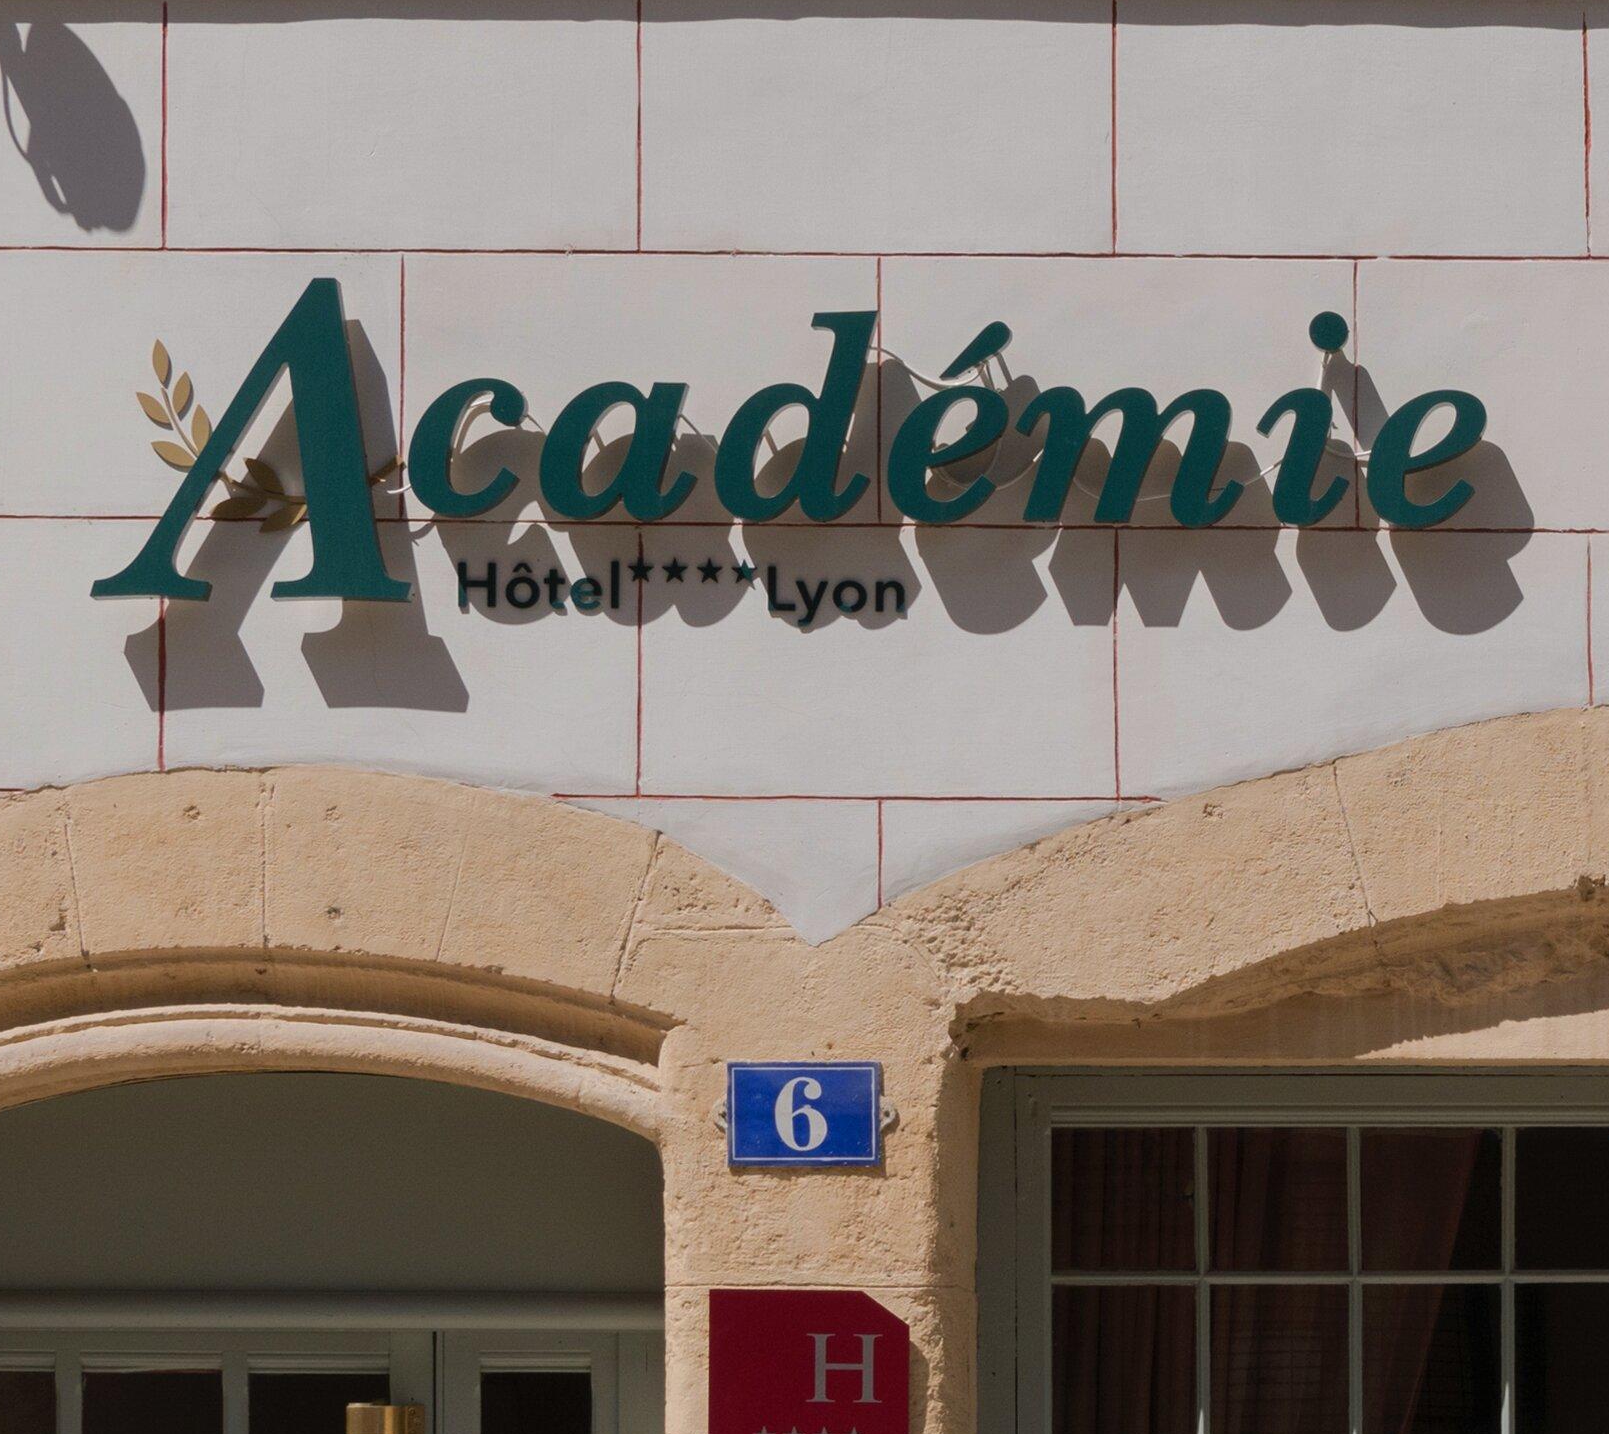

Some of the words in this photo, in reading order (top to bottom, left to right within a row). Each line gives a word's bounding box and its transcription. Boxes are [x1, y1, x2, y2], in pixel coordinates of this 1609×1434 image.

[91, 277, 1487, 603] Académie
[457, 561, 620, 610] Hôtel
[767, 565, 906, 626] Lyon
[774, 1076, 828, 1152] 6
[805, 1333, 884, 1404] H
